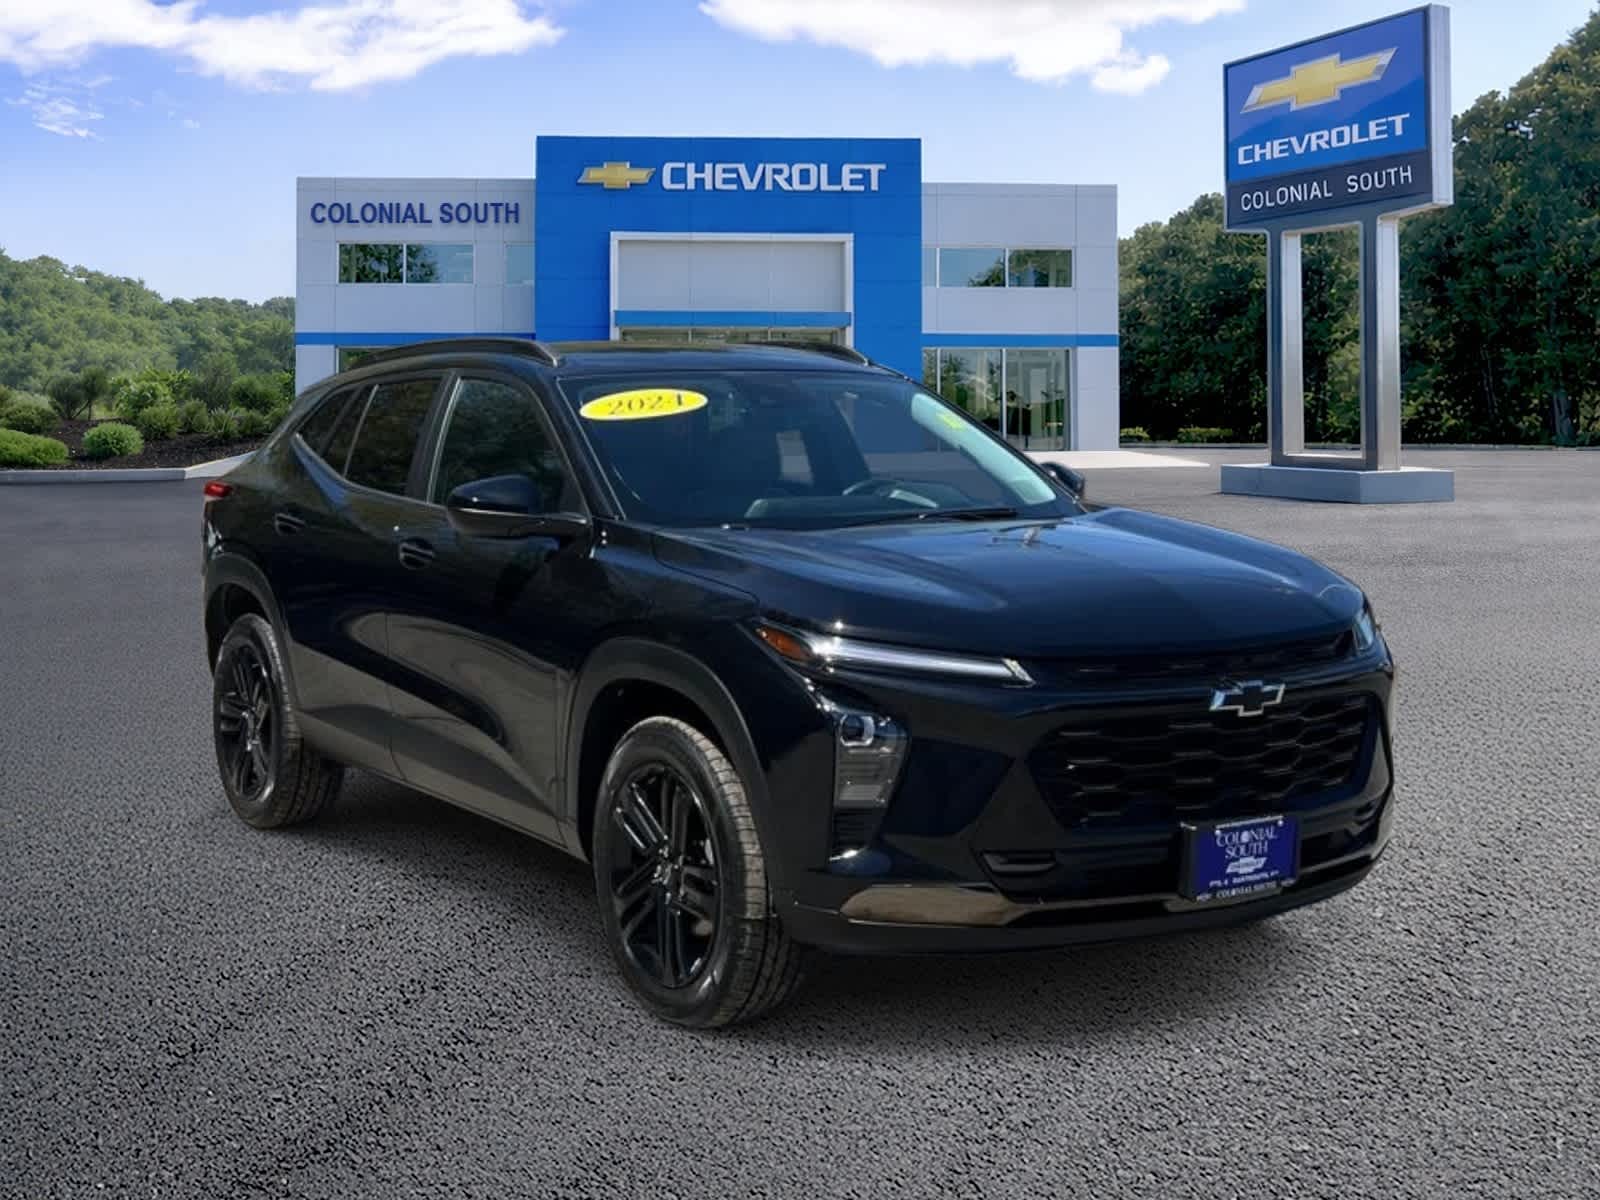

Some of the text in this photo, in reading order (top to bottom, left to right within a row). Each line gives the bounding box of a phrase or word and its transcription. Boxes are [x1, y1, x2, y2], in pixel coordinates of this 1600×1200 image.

[1238, 113, 1410, 165] CHEVROLET
[662, 162, 887, 191] CHEVROLET
[1240, 165, 1412, 211] COLONIAL SOUTH
[311, 202, 520, 224] COLONIAL SOUTH
[1216, 826, 1277, 847] COLONIAL
[1225, 840, 1268, 859] SOUTH
